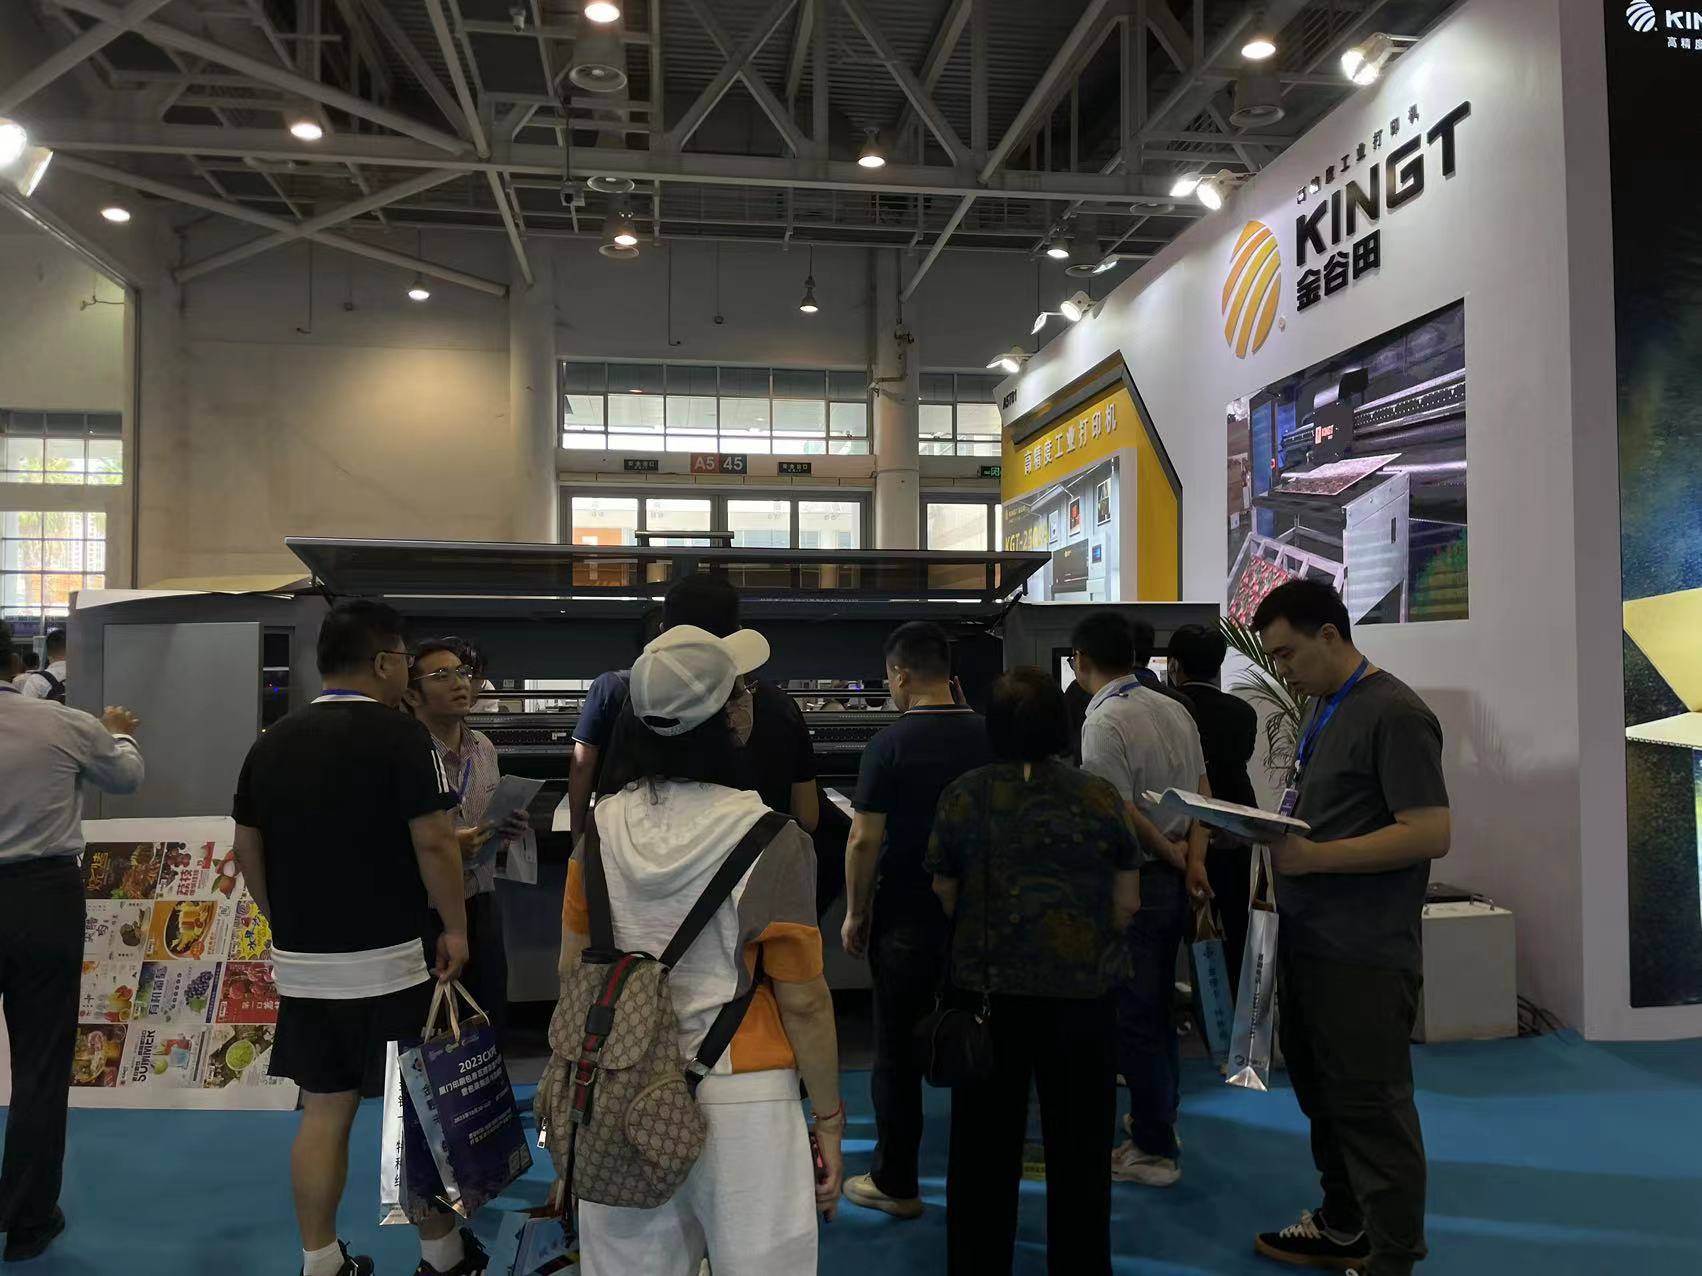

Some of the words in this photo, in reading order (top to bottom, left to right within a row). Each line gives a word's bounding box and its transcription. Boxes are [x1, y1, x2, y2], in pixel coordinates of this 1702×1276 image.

[1296, 100, 1472, 267] KINGT
[1296, 228, 1381, 312] 金谷田
[694, 456, 715, 470] A5
[723, 456, 743, 471] 45
[136, 1029, 156, 1082] SUMMER
